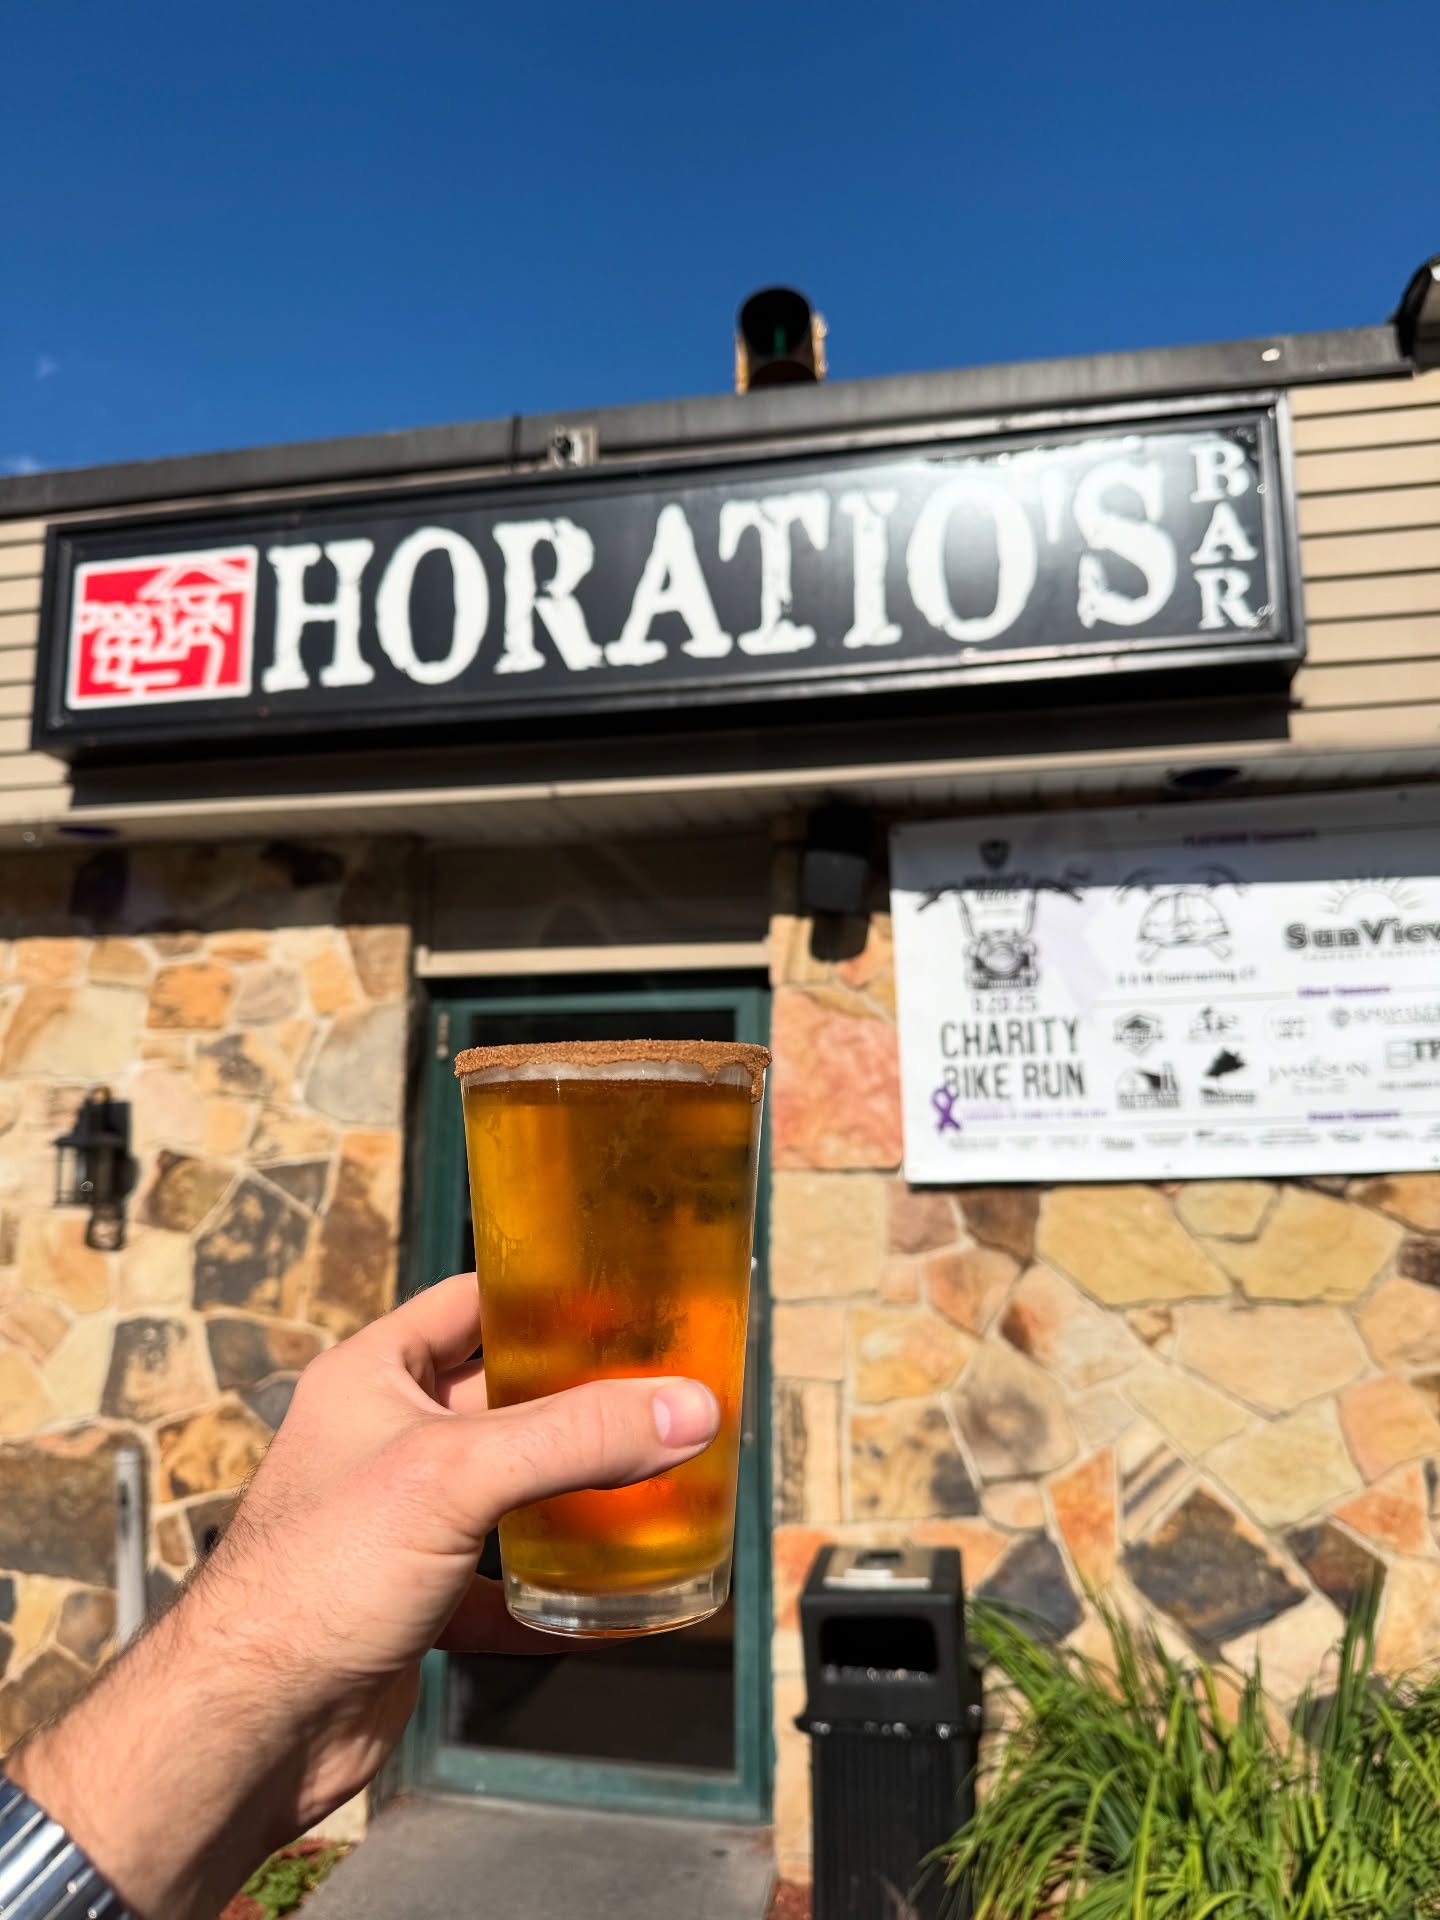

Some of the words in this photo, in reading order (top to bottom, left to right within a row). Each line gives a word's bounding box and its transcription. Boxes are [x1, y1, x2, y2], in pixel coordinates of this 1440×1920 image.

[261, 460, 1178, 693] HORATIO'S
[1189, 439, 1259, 630] BAR
[940, 1016, 1079, 1058] CHARITY
[942, 1062, 1011, 1101] BIKE
[1023, 1060, 1085, 1099] RUN
